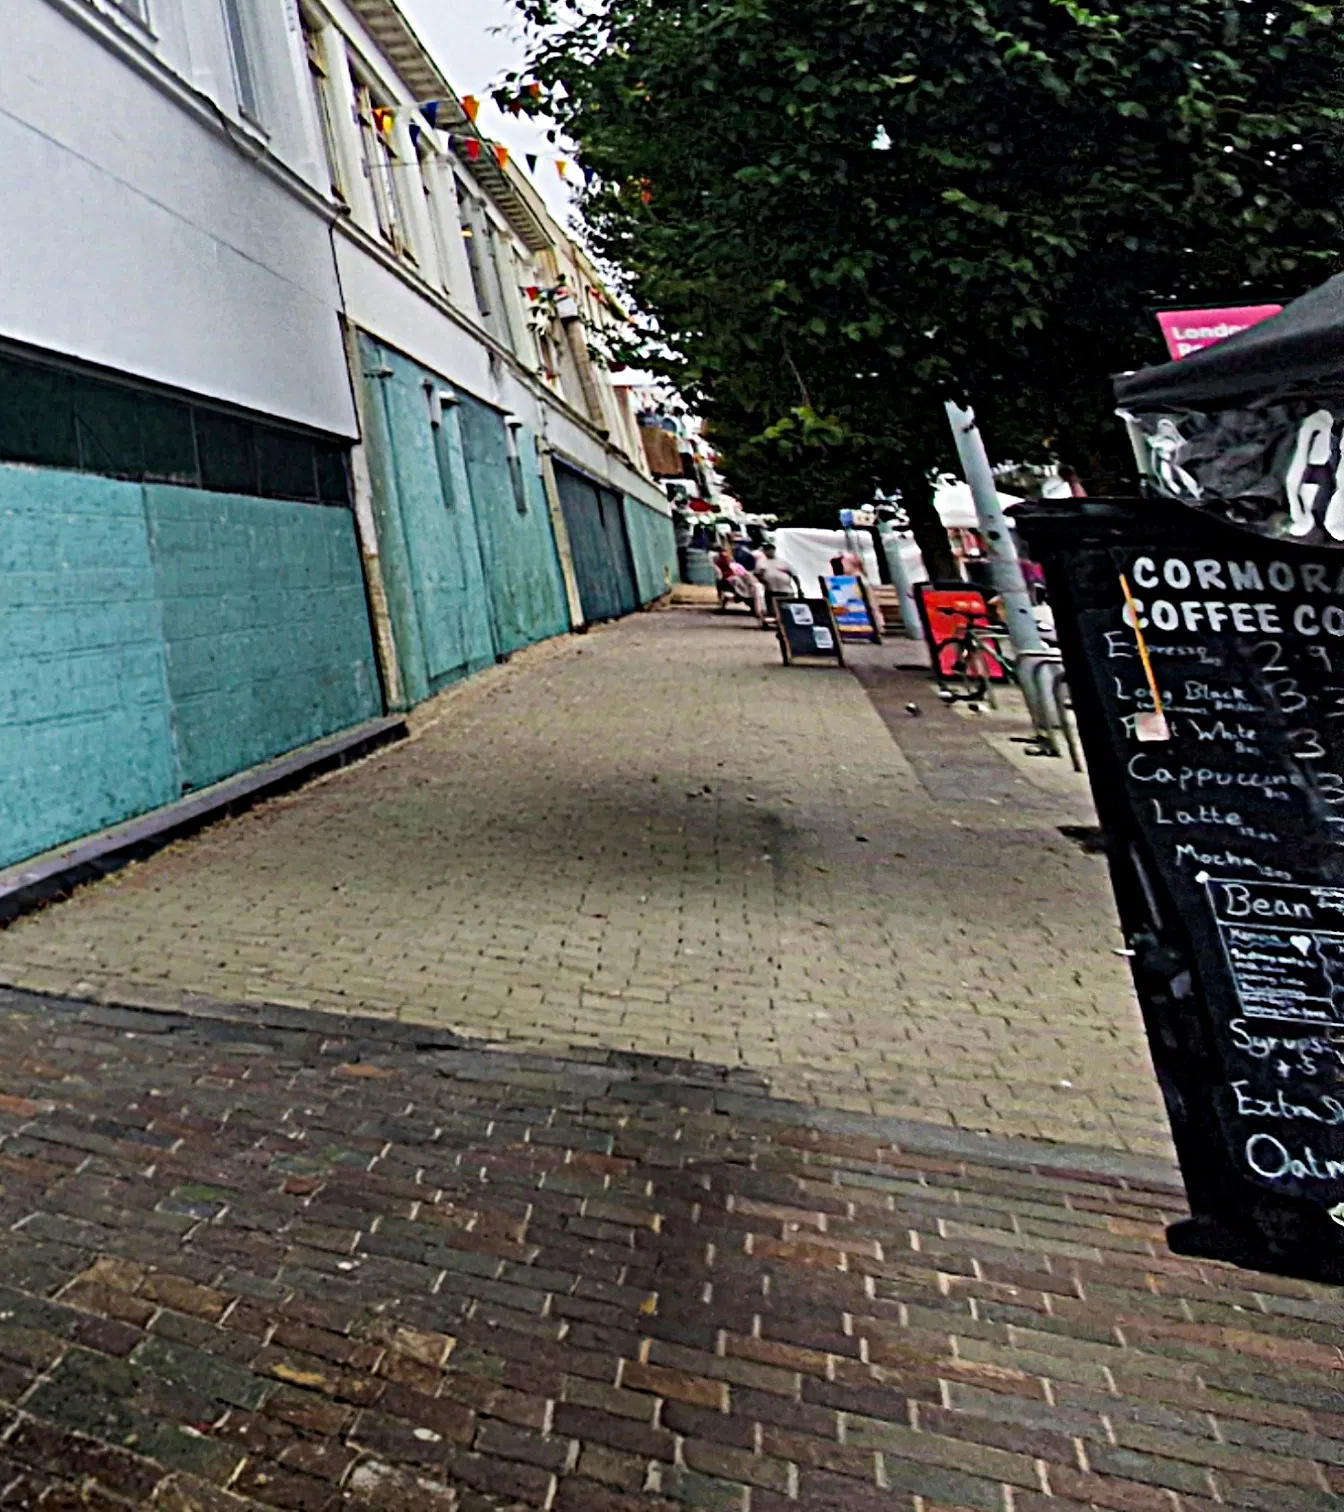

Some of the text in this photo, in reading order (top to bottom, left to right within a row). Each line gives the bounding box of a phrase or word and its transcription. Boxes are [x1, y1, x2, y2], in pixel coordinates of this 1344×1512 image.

[1123, 598, 1284, 634] COFFEE
[1185, 680, 1248, 701] Black
[1119, 712, 1180, 739] Ft
[1128, 753, 1305, 792] Cappuccino
[1151, 798, 1243, 827] Latte
[1175, 843, 1262, 867] Mocha
[1221, 883, 1313, 919] Bean
